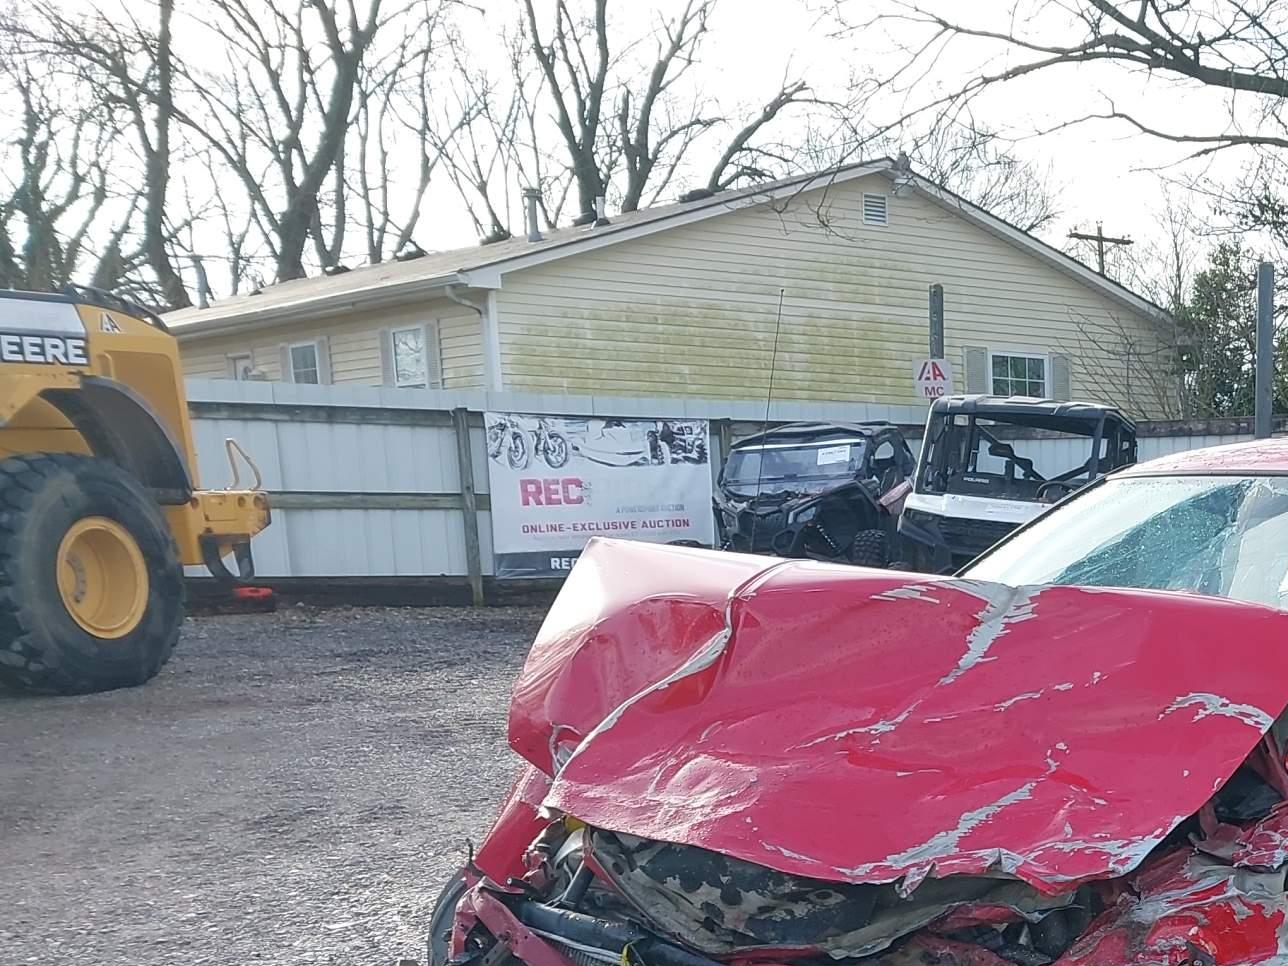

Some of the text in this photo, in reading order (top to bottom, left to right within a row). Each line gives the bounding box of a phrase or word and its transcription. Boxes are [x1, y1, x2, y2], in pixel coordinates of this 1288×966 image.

[924, 386, 945, 397] MC
[523, 519, 690, 533] ONLINE-EXCLUSIVE AUCTION
